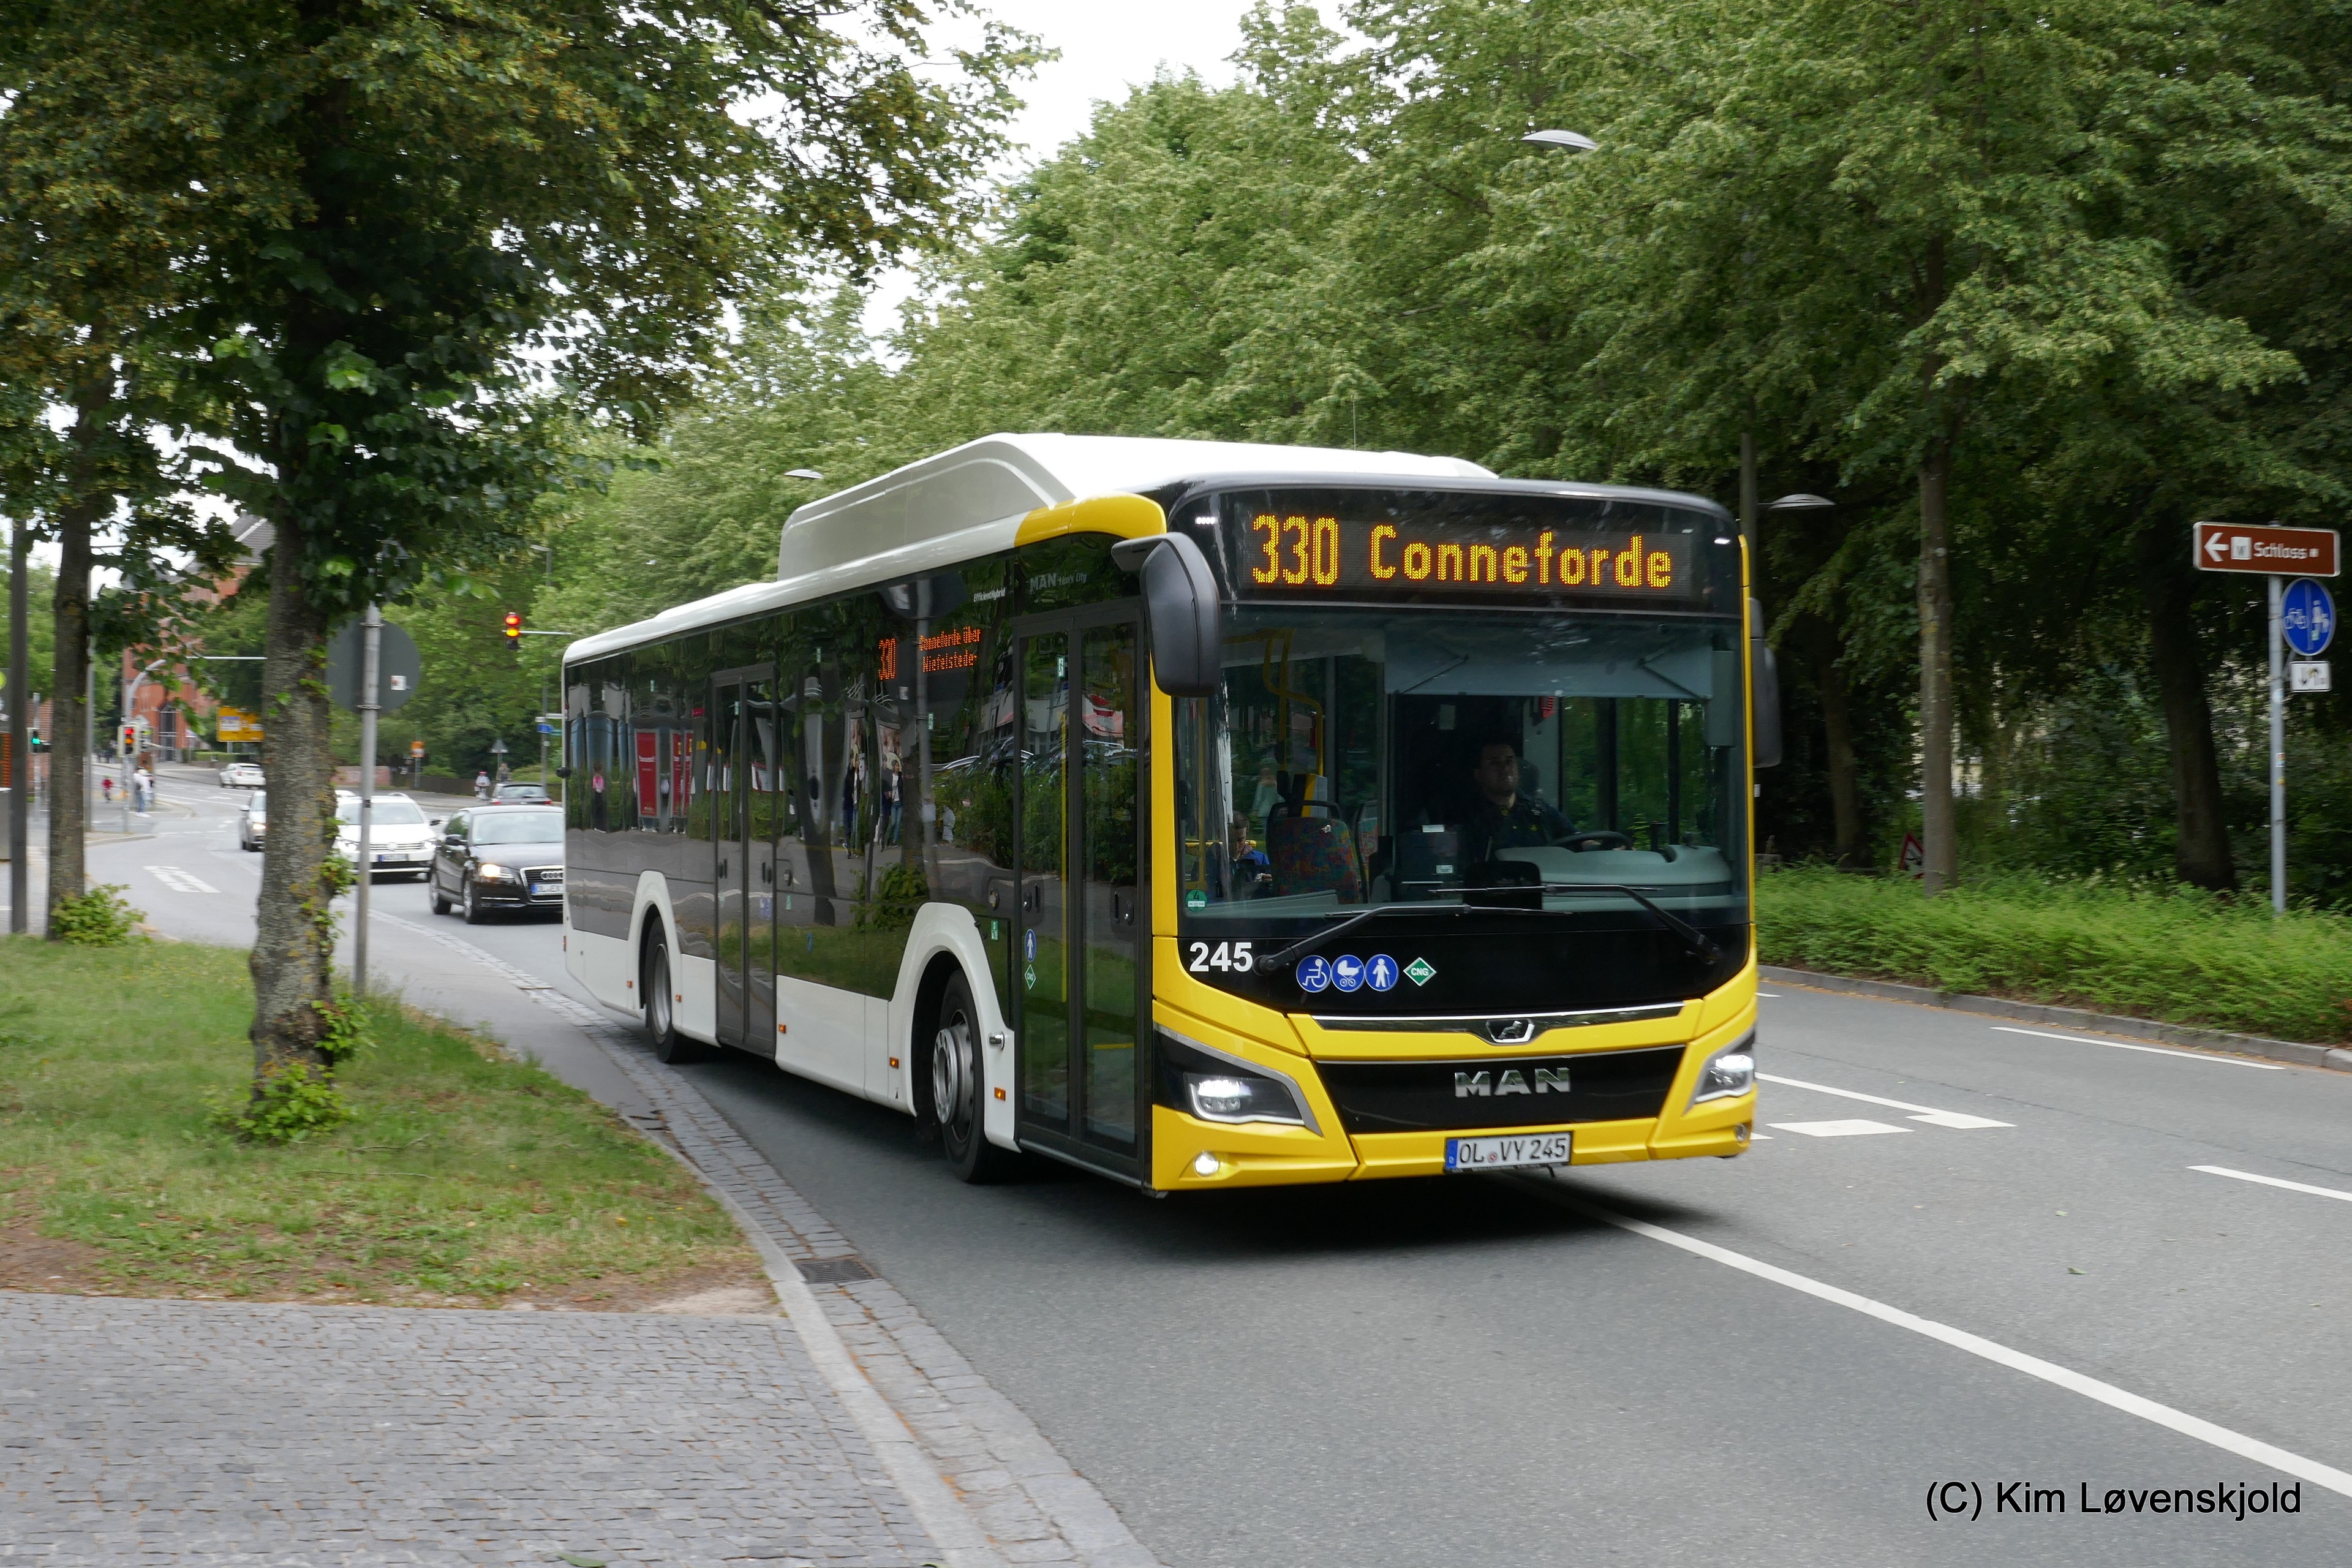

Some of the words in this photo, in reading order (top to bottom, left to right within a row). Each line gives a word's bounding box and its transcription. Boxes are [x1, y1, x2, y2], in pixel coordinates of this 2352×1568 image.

[1251, 514, 1340, 586] 330
[1370, 524, 1672, 589] Conneforde
[2253, 541, 2309, 560] Schloss
[1030, 571, 1057, 590] MAN
[1193, 890, 1200, 901] 4
[1189, 941, 1253, 972] 245
[1411, 967, 1430, 976] CNG
[1454, 1067, 1572, 1098] MAN
[1460, 1142, 1485, 1164] OL
[1500, 1139, 1526, 1161] VY
[1529, 1136, 1566, 1159] 245
